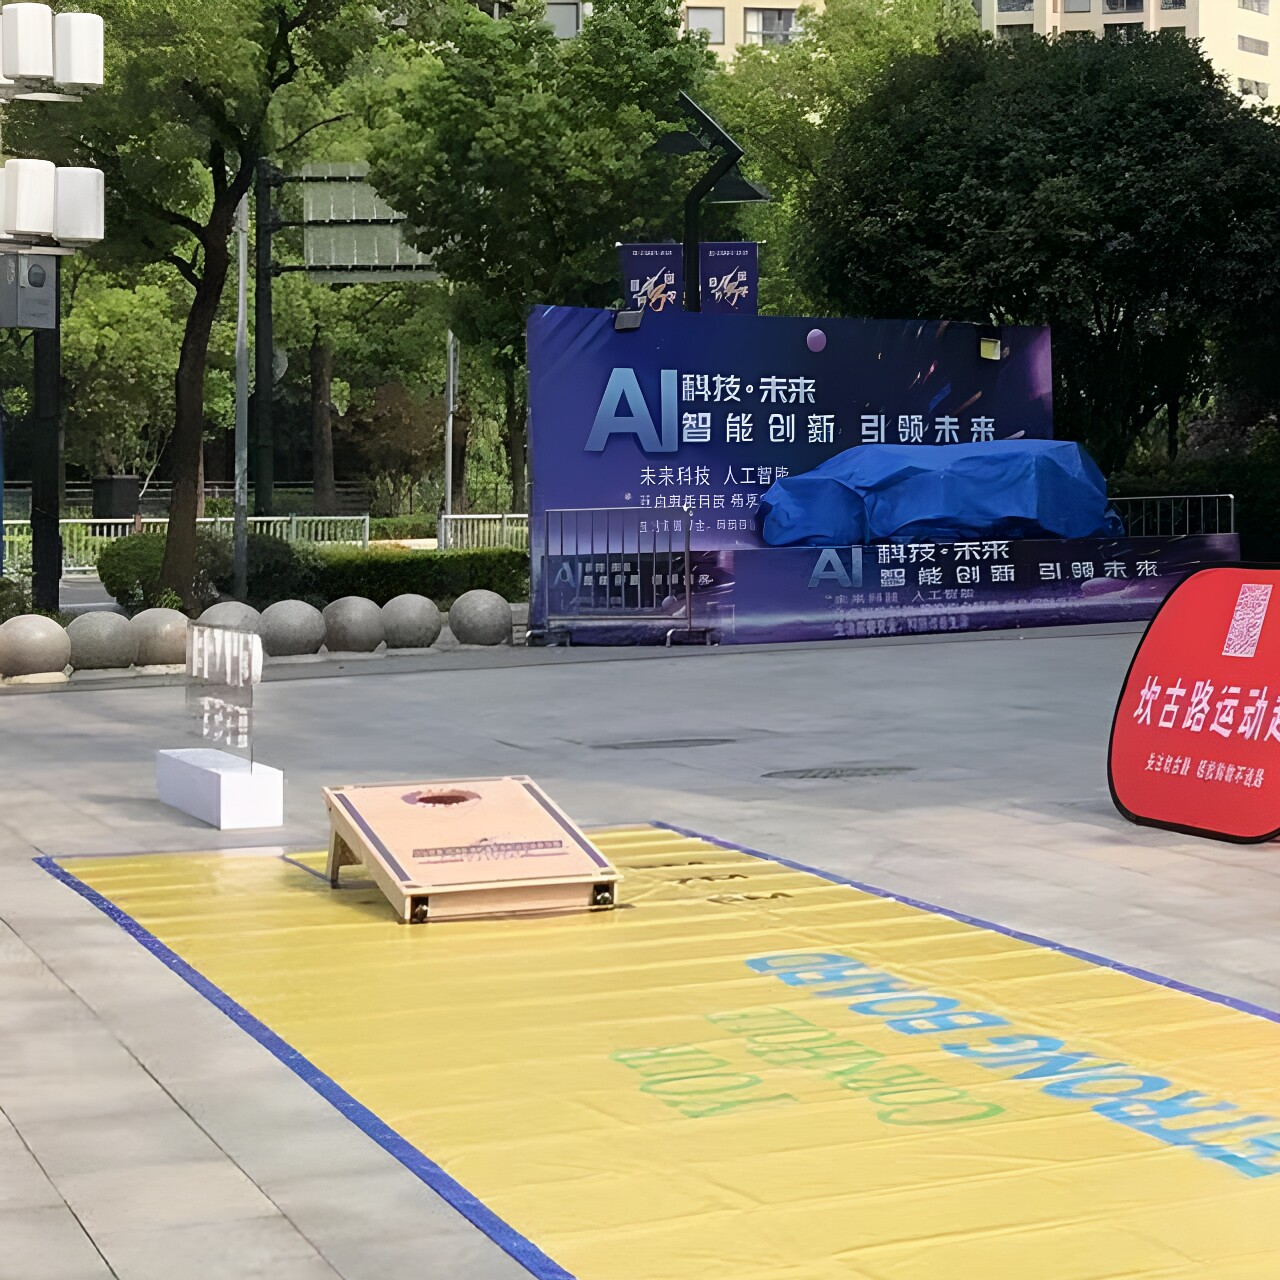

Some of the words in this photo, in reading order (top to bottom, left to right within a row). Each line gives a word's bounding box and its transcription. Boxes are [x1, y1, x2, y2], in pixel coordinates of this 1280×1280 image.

[583, 367, 678, 452] AI
[682, 412, 835, 443] 智能创新
[860, 414, 996, 443] 引领未来
[640, 466, 711, 486] 未来科技
[807, 547, 863, 588] AI
[742, 951, 1012, 1036] BOARD
